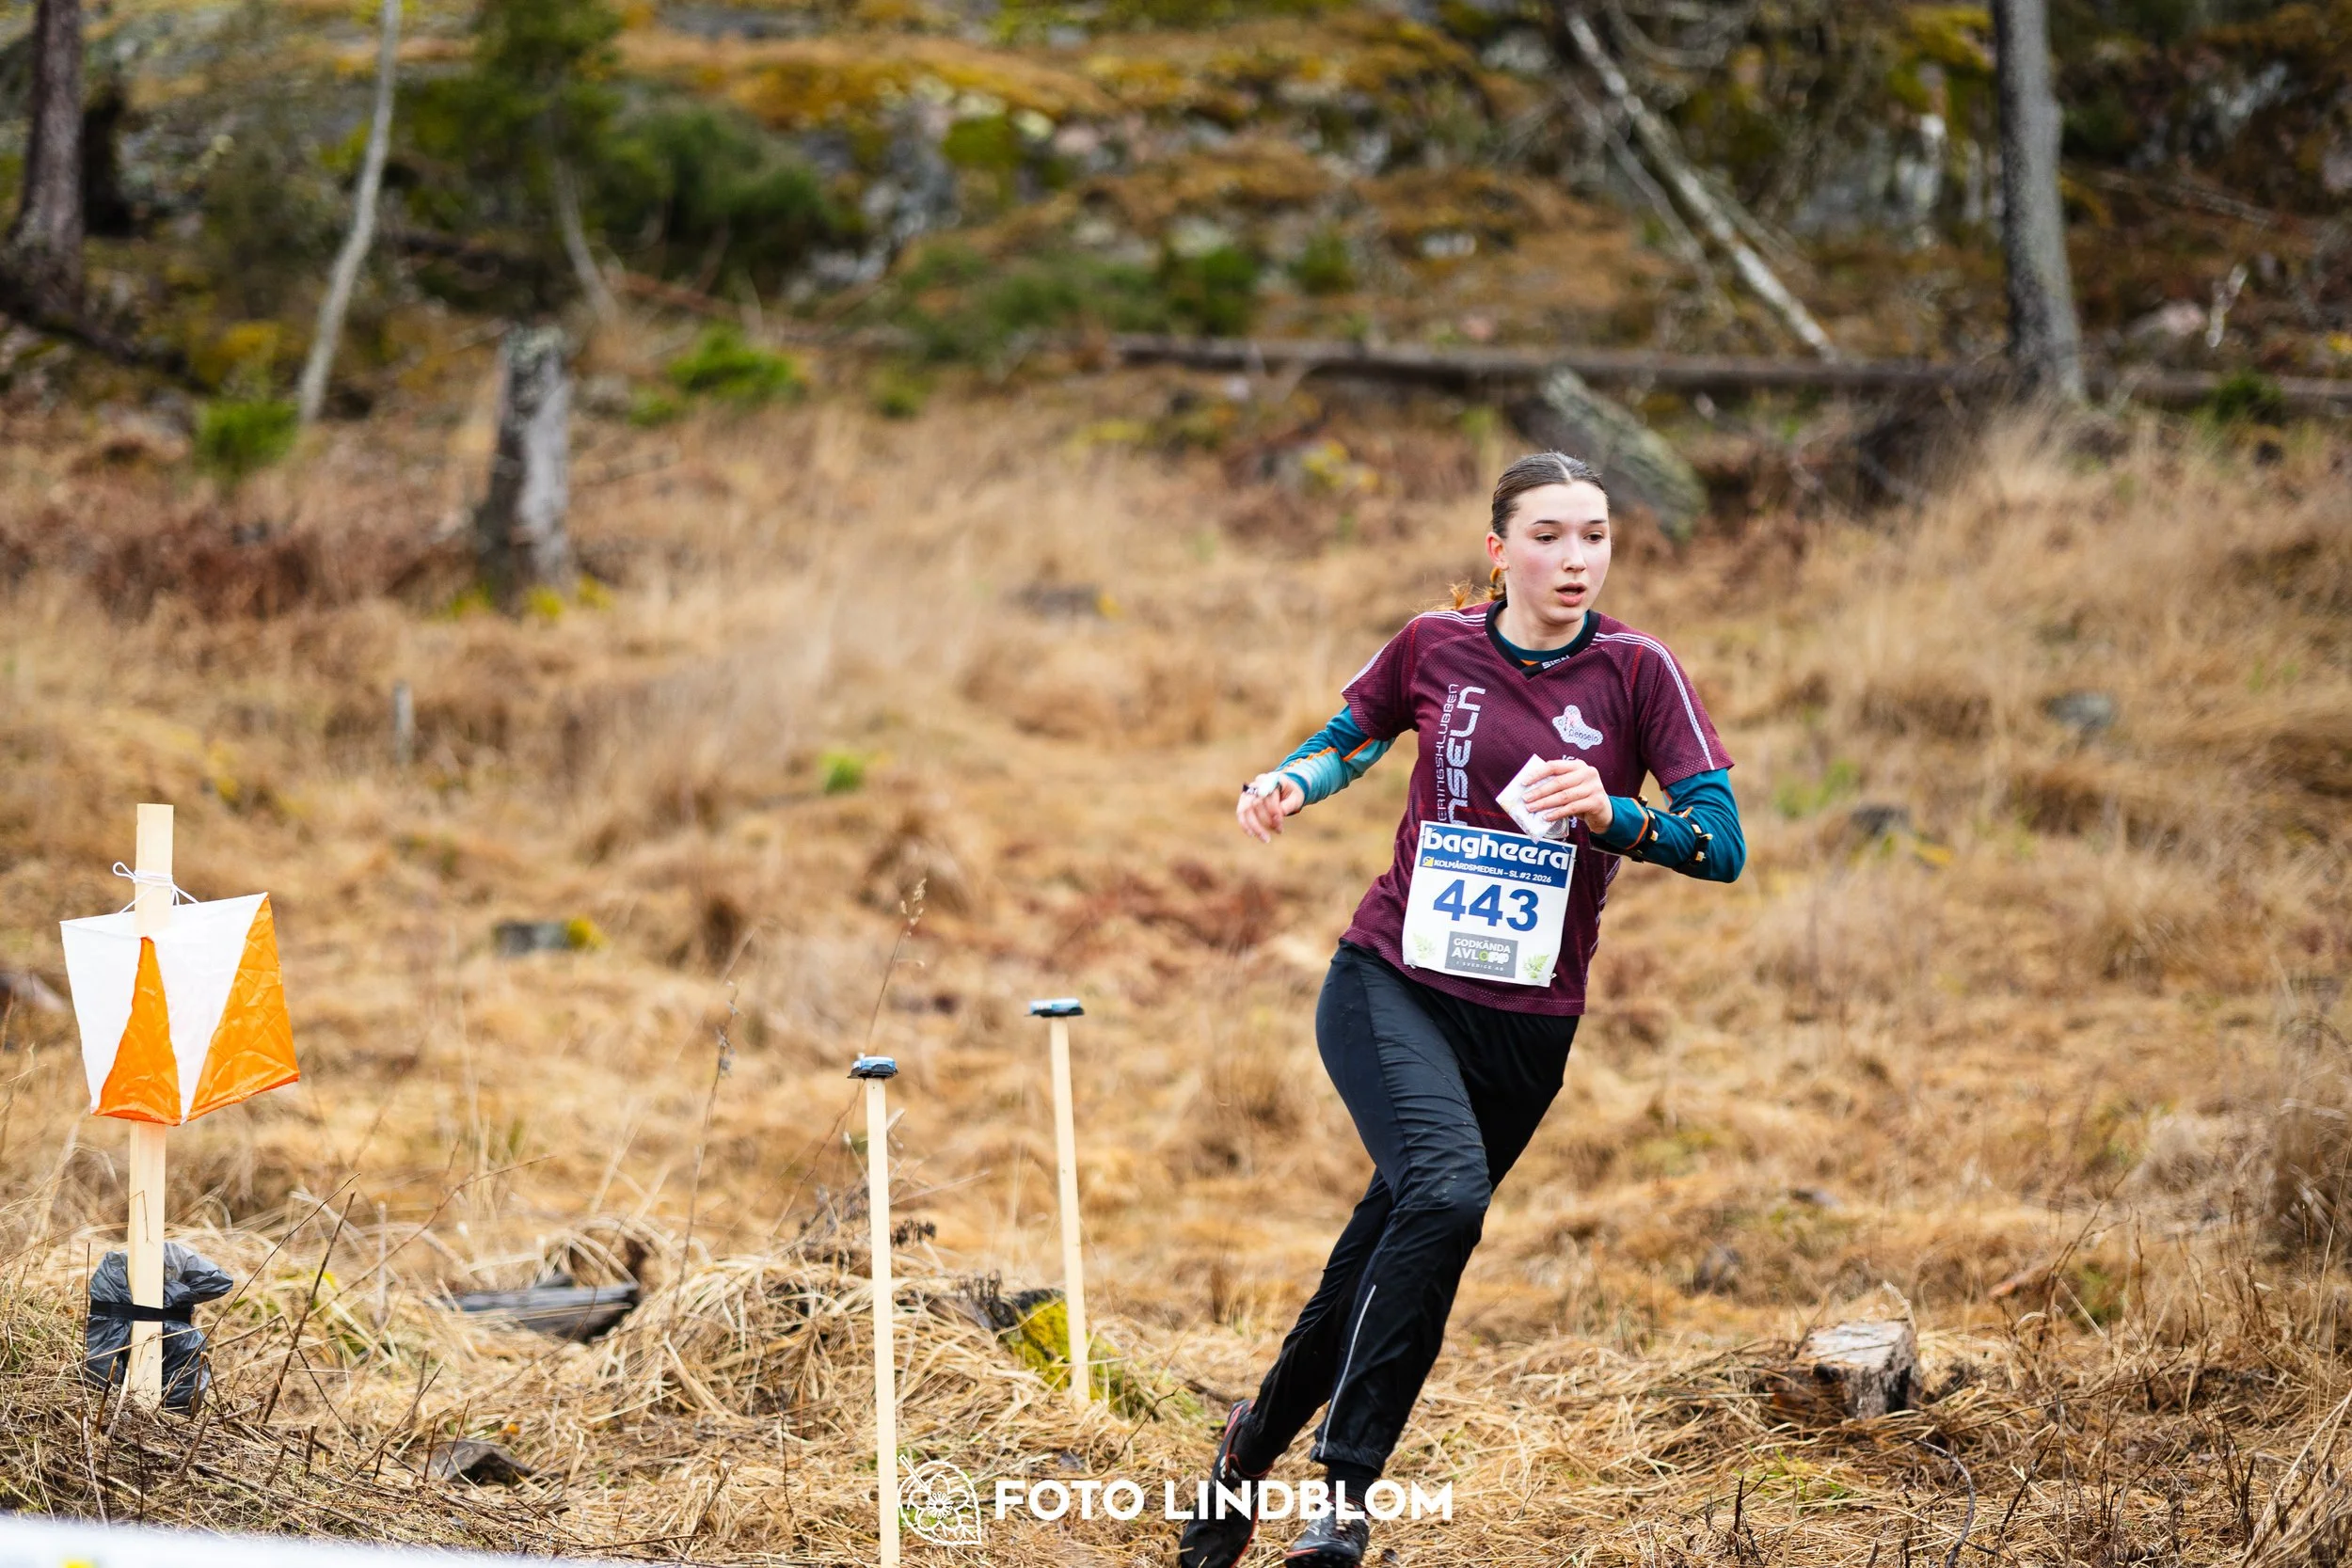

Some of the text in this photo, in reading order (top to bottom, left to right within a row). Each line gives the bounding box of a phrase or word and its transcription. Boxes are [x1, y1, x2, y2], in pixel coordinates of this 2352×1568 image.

[1422, 827, 1570, 870] bagheera
[1433, 860, 1503, 876] KOLMÅRDSMEDELN
[1508, 870, 1518, 879] SL
[1519, 872, 1531, 880] #2
[1532, 874, 1551, 883] 2026
[1433, 879, 1539, 931] 443
[1451, 947, 1510, 964] AVLOPP
[1453, 938, 1511, 954] GODKÄNDA
